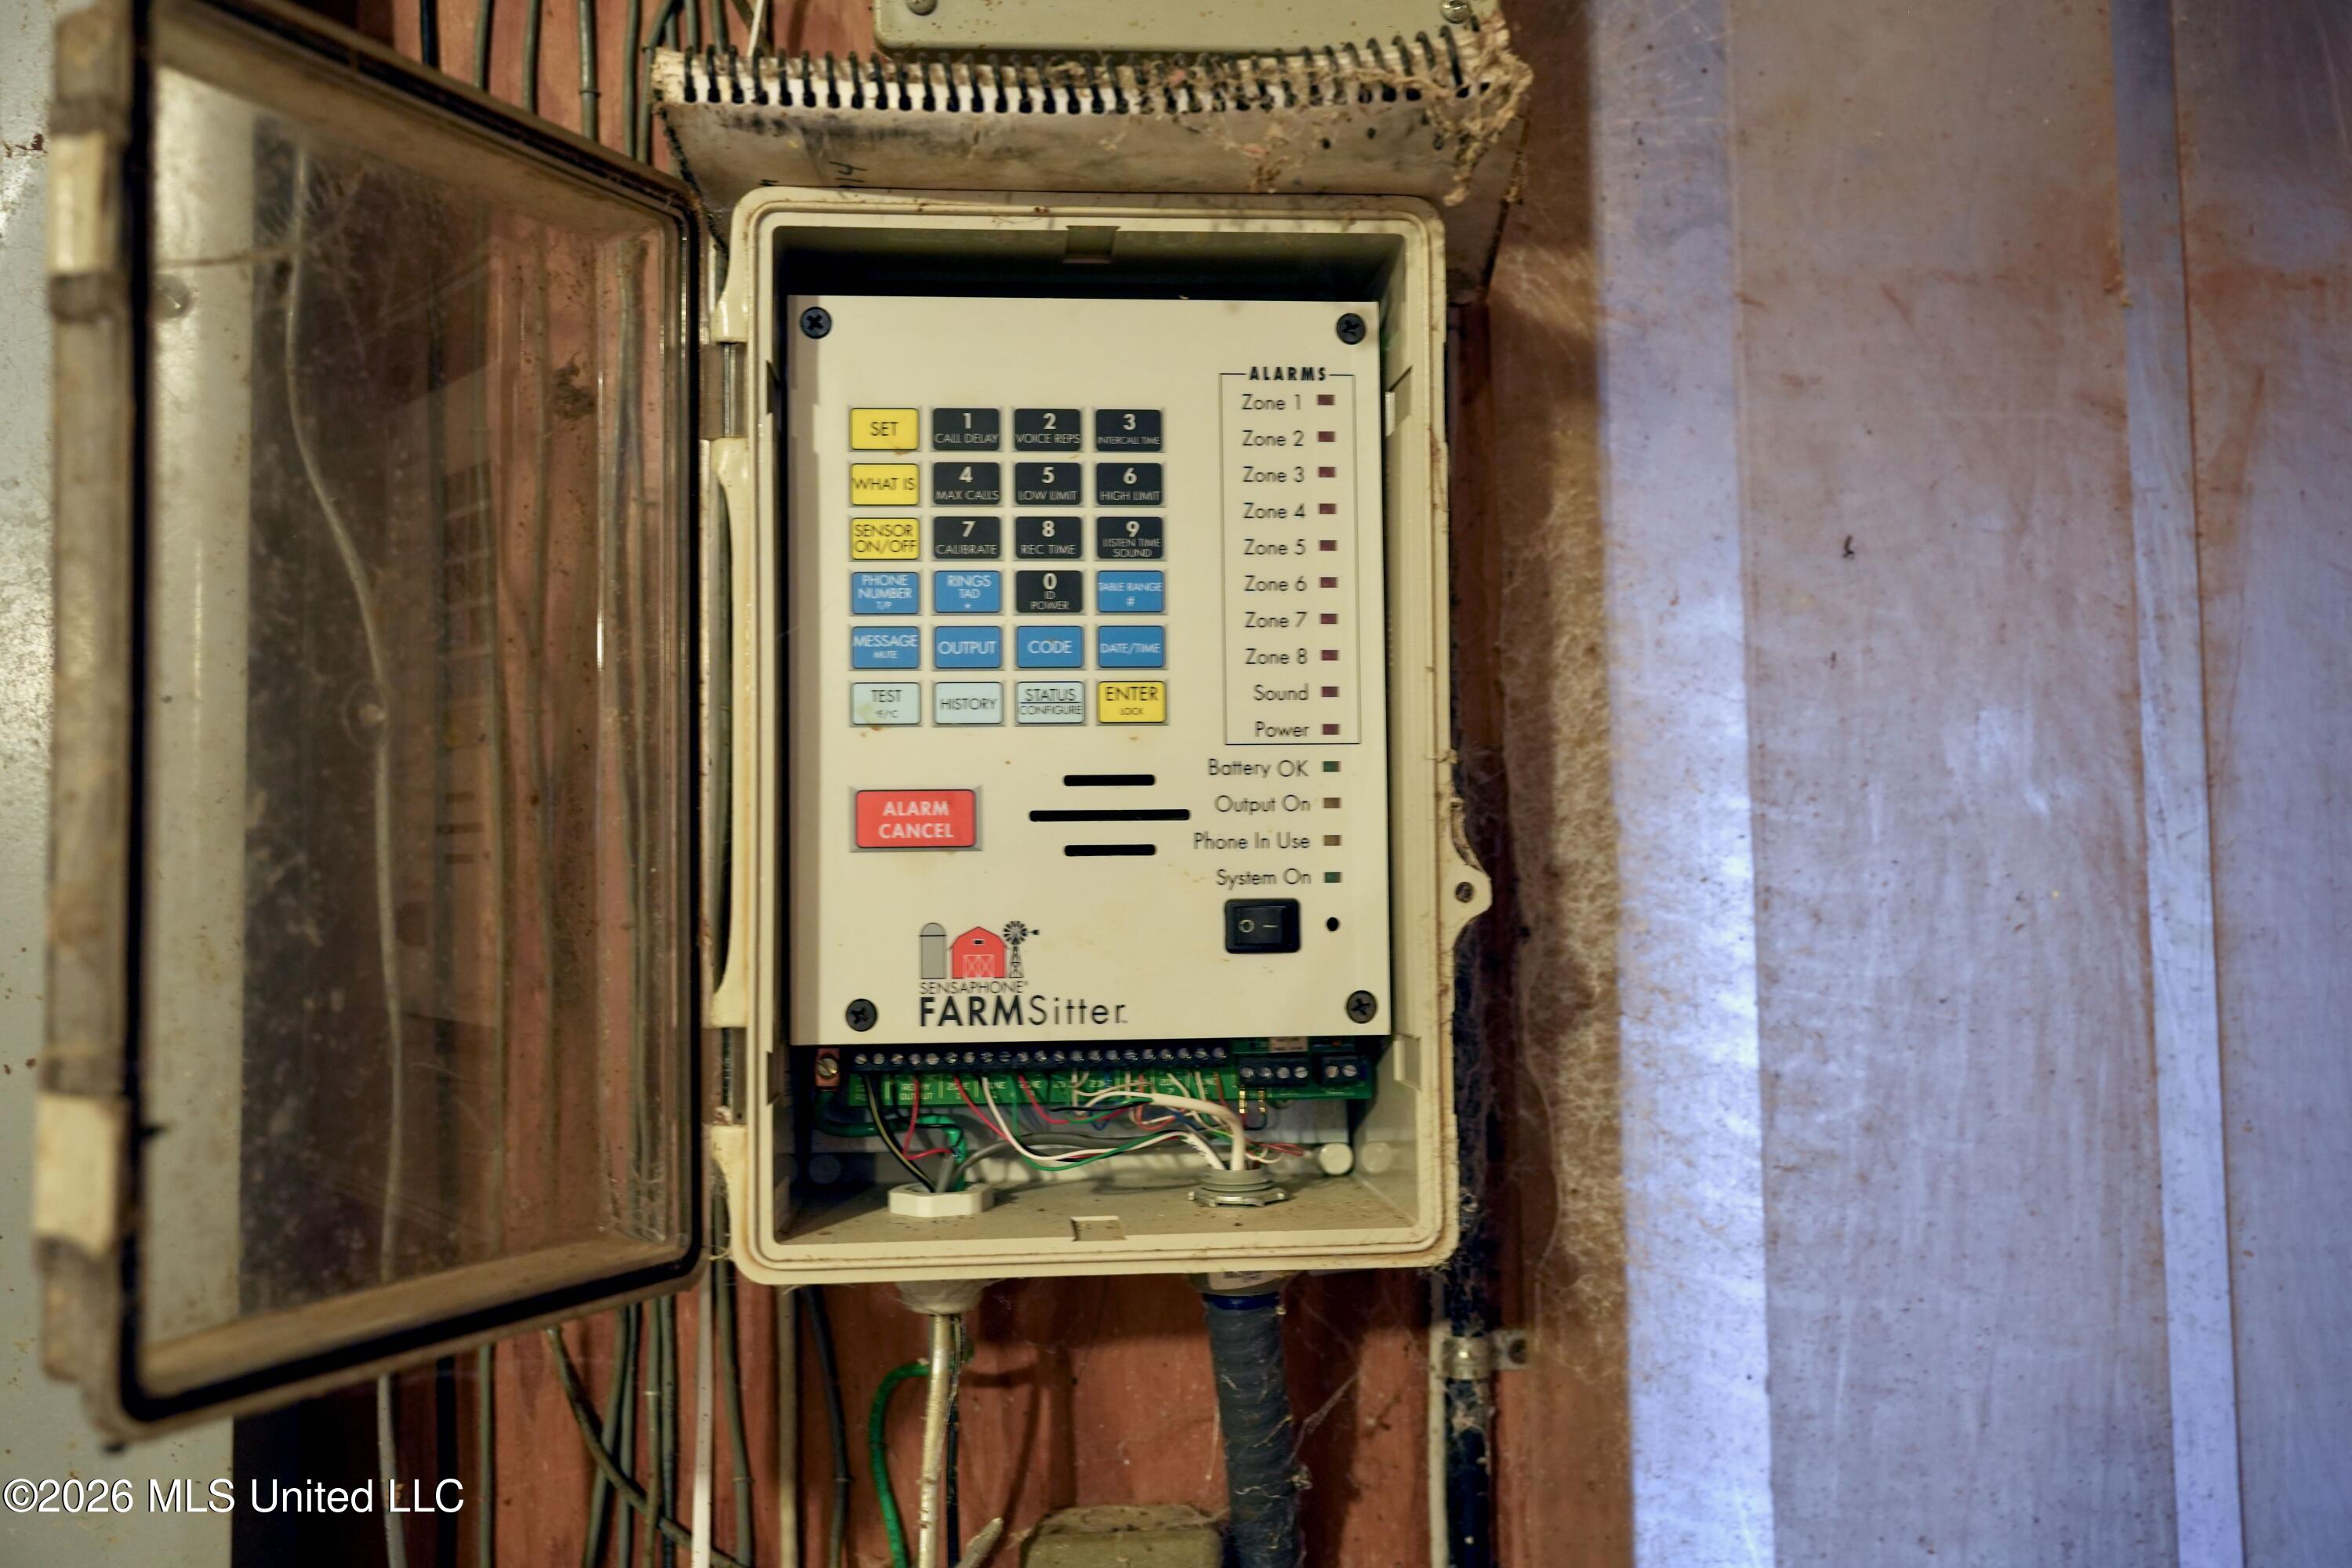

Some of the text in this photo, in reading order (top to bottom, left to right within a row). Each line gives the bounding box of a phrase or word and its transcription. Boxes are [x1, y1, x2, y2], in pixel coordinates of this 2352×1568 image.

[1249, 366, 1326, 381] ALARMS
[1241, 394, 1301, 410] Zone 1
[963, 413, 971, 429] 1
[1043, 412, 1056, 429] 2
[1123, 413, 1136, 430] 3
[870, 422, 898, 437] SET
[935, 434, 999, 444] CALL DELAY
[1016, 434, 1081, 444] VOICE REPS
[1141, 436, 1160, 445] TIME
[1242, 430, 1305, 446] Zone 2
[959, 466, 973, 483] 4
[1041, 467, 1054, 484] 5
[1123, 468, 1137, 484] 6
[1243, 466, 1305, 482] Zone 3
[853, 477, 916, 490] WHAT IS
[935, 490, 1000, 500] MAX CALLS
[1019, 491, 1077, 500] LOW LIMIT
[1101, 491, 1160, 500] HIGH LIMIT
[1243, 503, 1305, 518] Zone 4
[855, 524, 913, 537] SENSOR
[961, 521, 975, 537] 7
[1042, 521, 1055, 537] 8
[1126, 521, 1140, 538] 9
[855, 540, 916, 554] ON/OFF
[935, 544, 997, 554] CALIBRATE
[1021, 544, 1075, 554] REC TIME
[1138, 539, 1161, 547] TIME
[1243, 539, 1306, 555] Zone 5
[1112, 549, 1152, 557] SOUND
[862, 575, 909, 586] PHONE
[947, 575, 991, 587] RINGS
[1244, 575, 1307, 591] Zone 6
[858, 588, 912, 599] NUMBER
[959, 589, 980, 599] TAD
[1044, 591, 1055, 600] ID
[1031, 601, 1069, 610] POWER
[1244, 612, 1308, 628] Zone 7
[853, 635, 918, 647] MESSAGE
[938, 641, 996, 655] OUTPUT
[1027, 641, 1073, 654] CODE
[873, 650, 898, 659] MUTE
[1100, 643, 1160, 655] DATE/TIME
[1245, 648, 1308, 664] Zone 8
[871, 689, 902, 702] TEST
[1024, 688, 1077, 702] STATUS
[1105, 687, 1158, 702] ENTER
[1254, 683, 1308, 700] Sound
[941, 699, 996, 711] HISTORY
[1018, 706, 1083, 716] CONFIGURE
[1254, 721, 1310, 737] Power
[1208, 759, 1309, 778] Battery OK
[882, 801, 949, 816] ALARM
[1214, 794, 1311, 815] Output On
[878, 823, 953, 839] CANCEL
[1193, 831, 1310, 849] Phone In Use
[1216, 868, 1311, 891] System On
